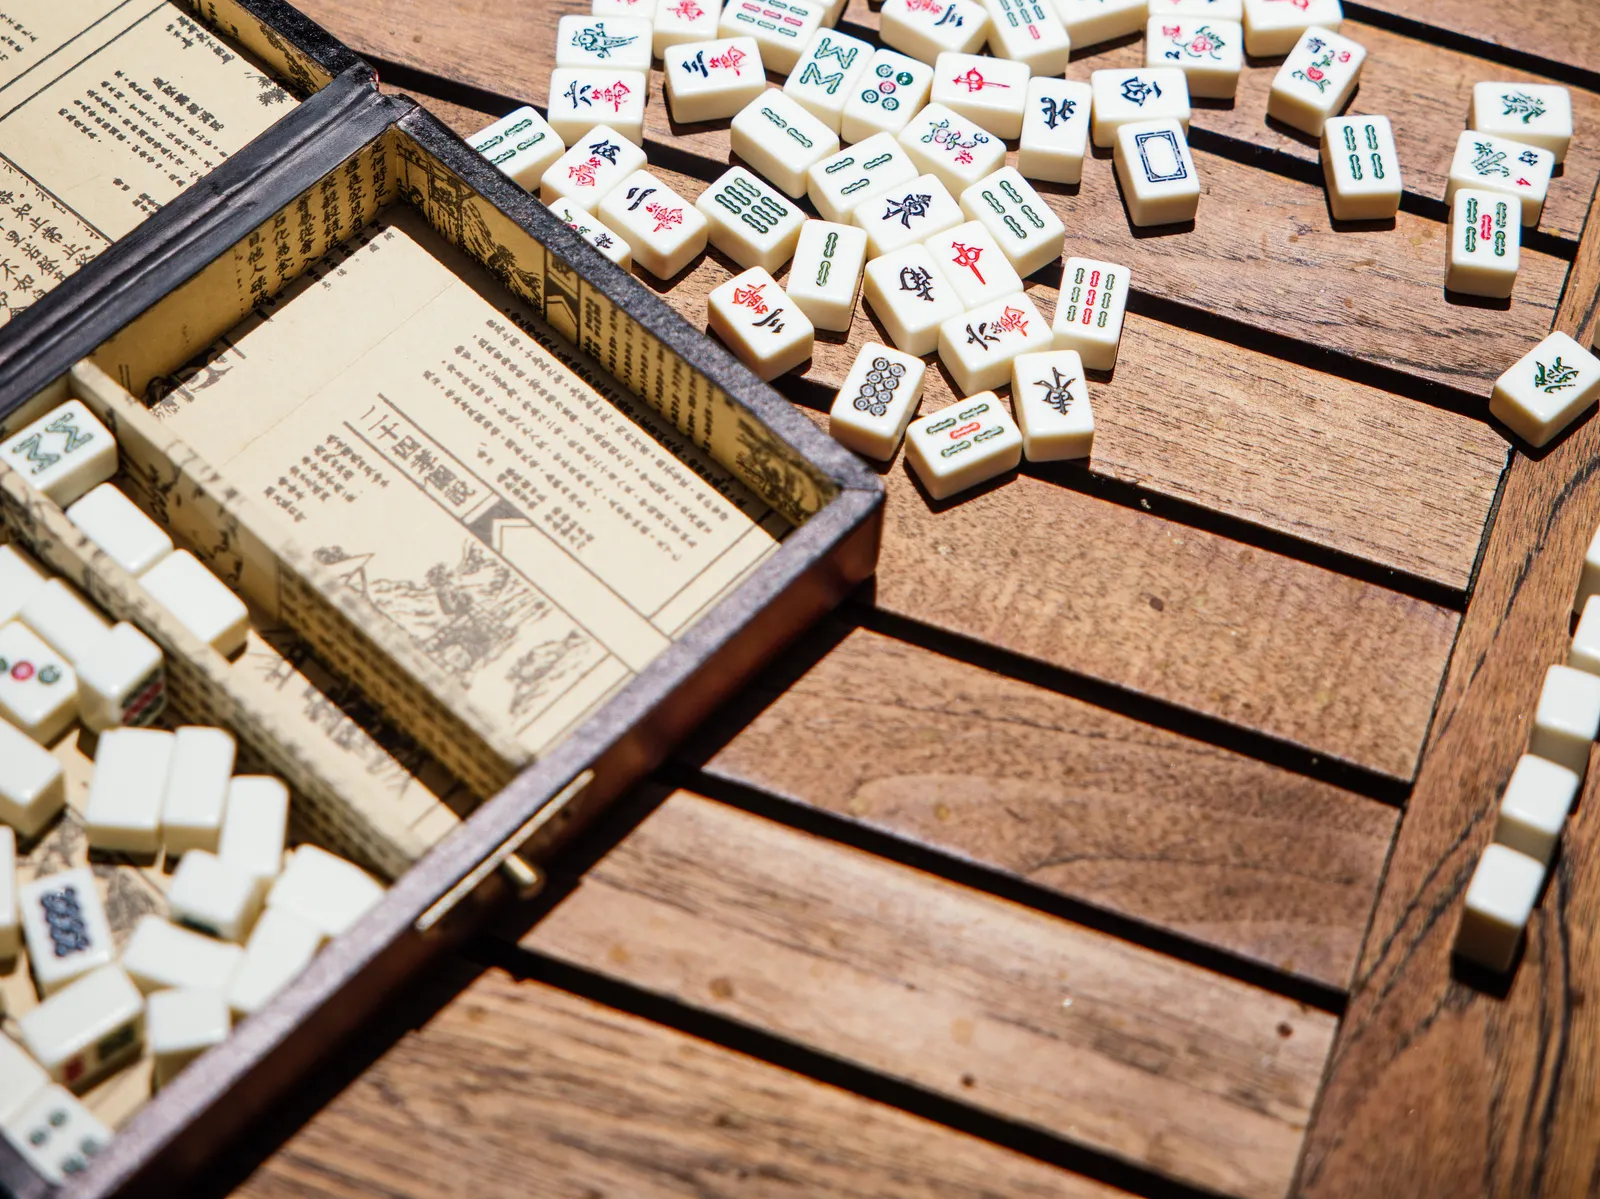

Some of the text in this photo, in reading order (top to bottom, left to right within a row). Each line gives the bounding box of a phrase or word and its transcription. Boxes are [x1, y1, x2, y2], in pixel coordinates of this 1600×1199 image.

[682, 46, 747, 78] 三萬
[1165, 50, 1180, 60] 2
[1338, 51, 1351, 63] 3
[563, 80, 630, 112] 六萬
[952, 67, 1010, 92] 中
[1040, 96, 1076, 130] 北
[974, 133, 989, 144] 3
[1516, 177, 1532, 187] 4
[626, 187, 683, 232] 二萬
[882, 194, 931, 230] 東
[952, 241, 986, 285] 中
[732, 283, 785, 333] 三萬
[966, 306, 1029, 351] 六萬
[1033, 366, 1076, 416] 東
